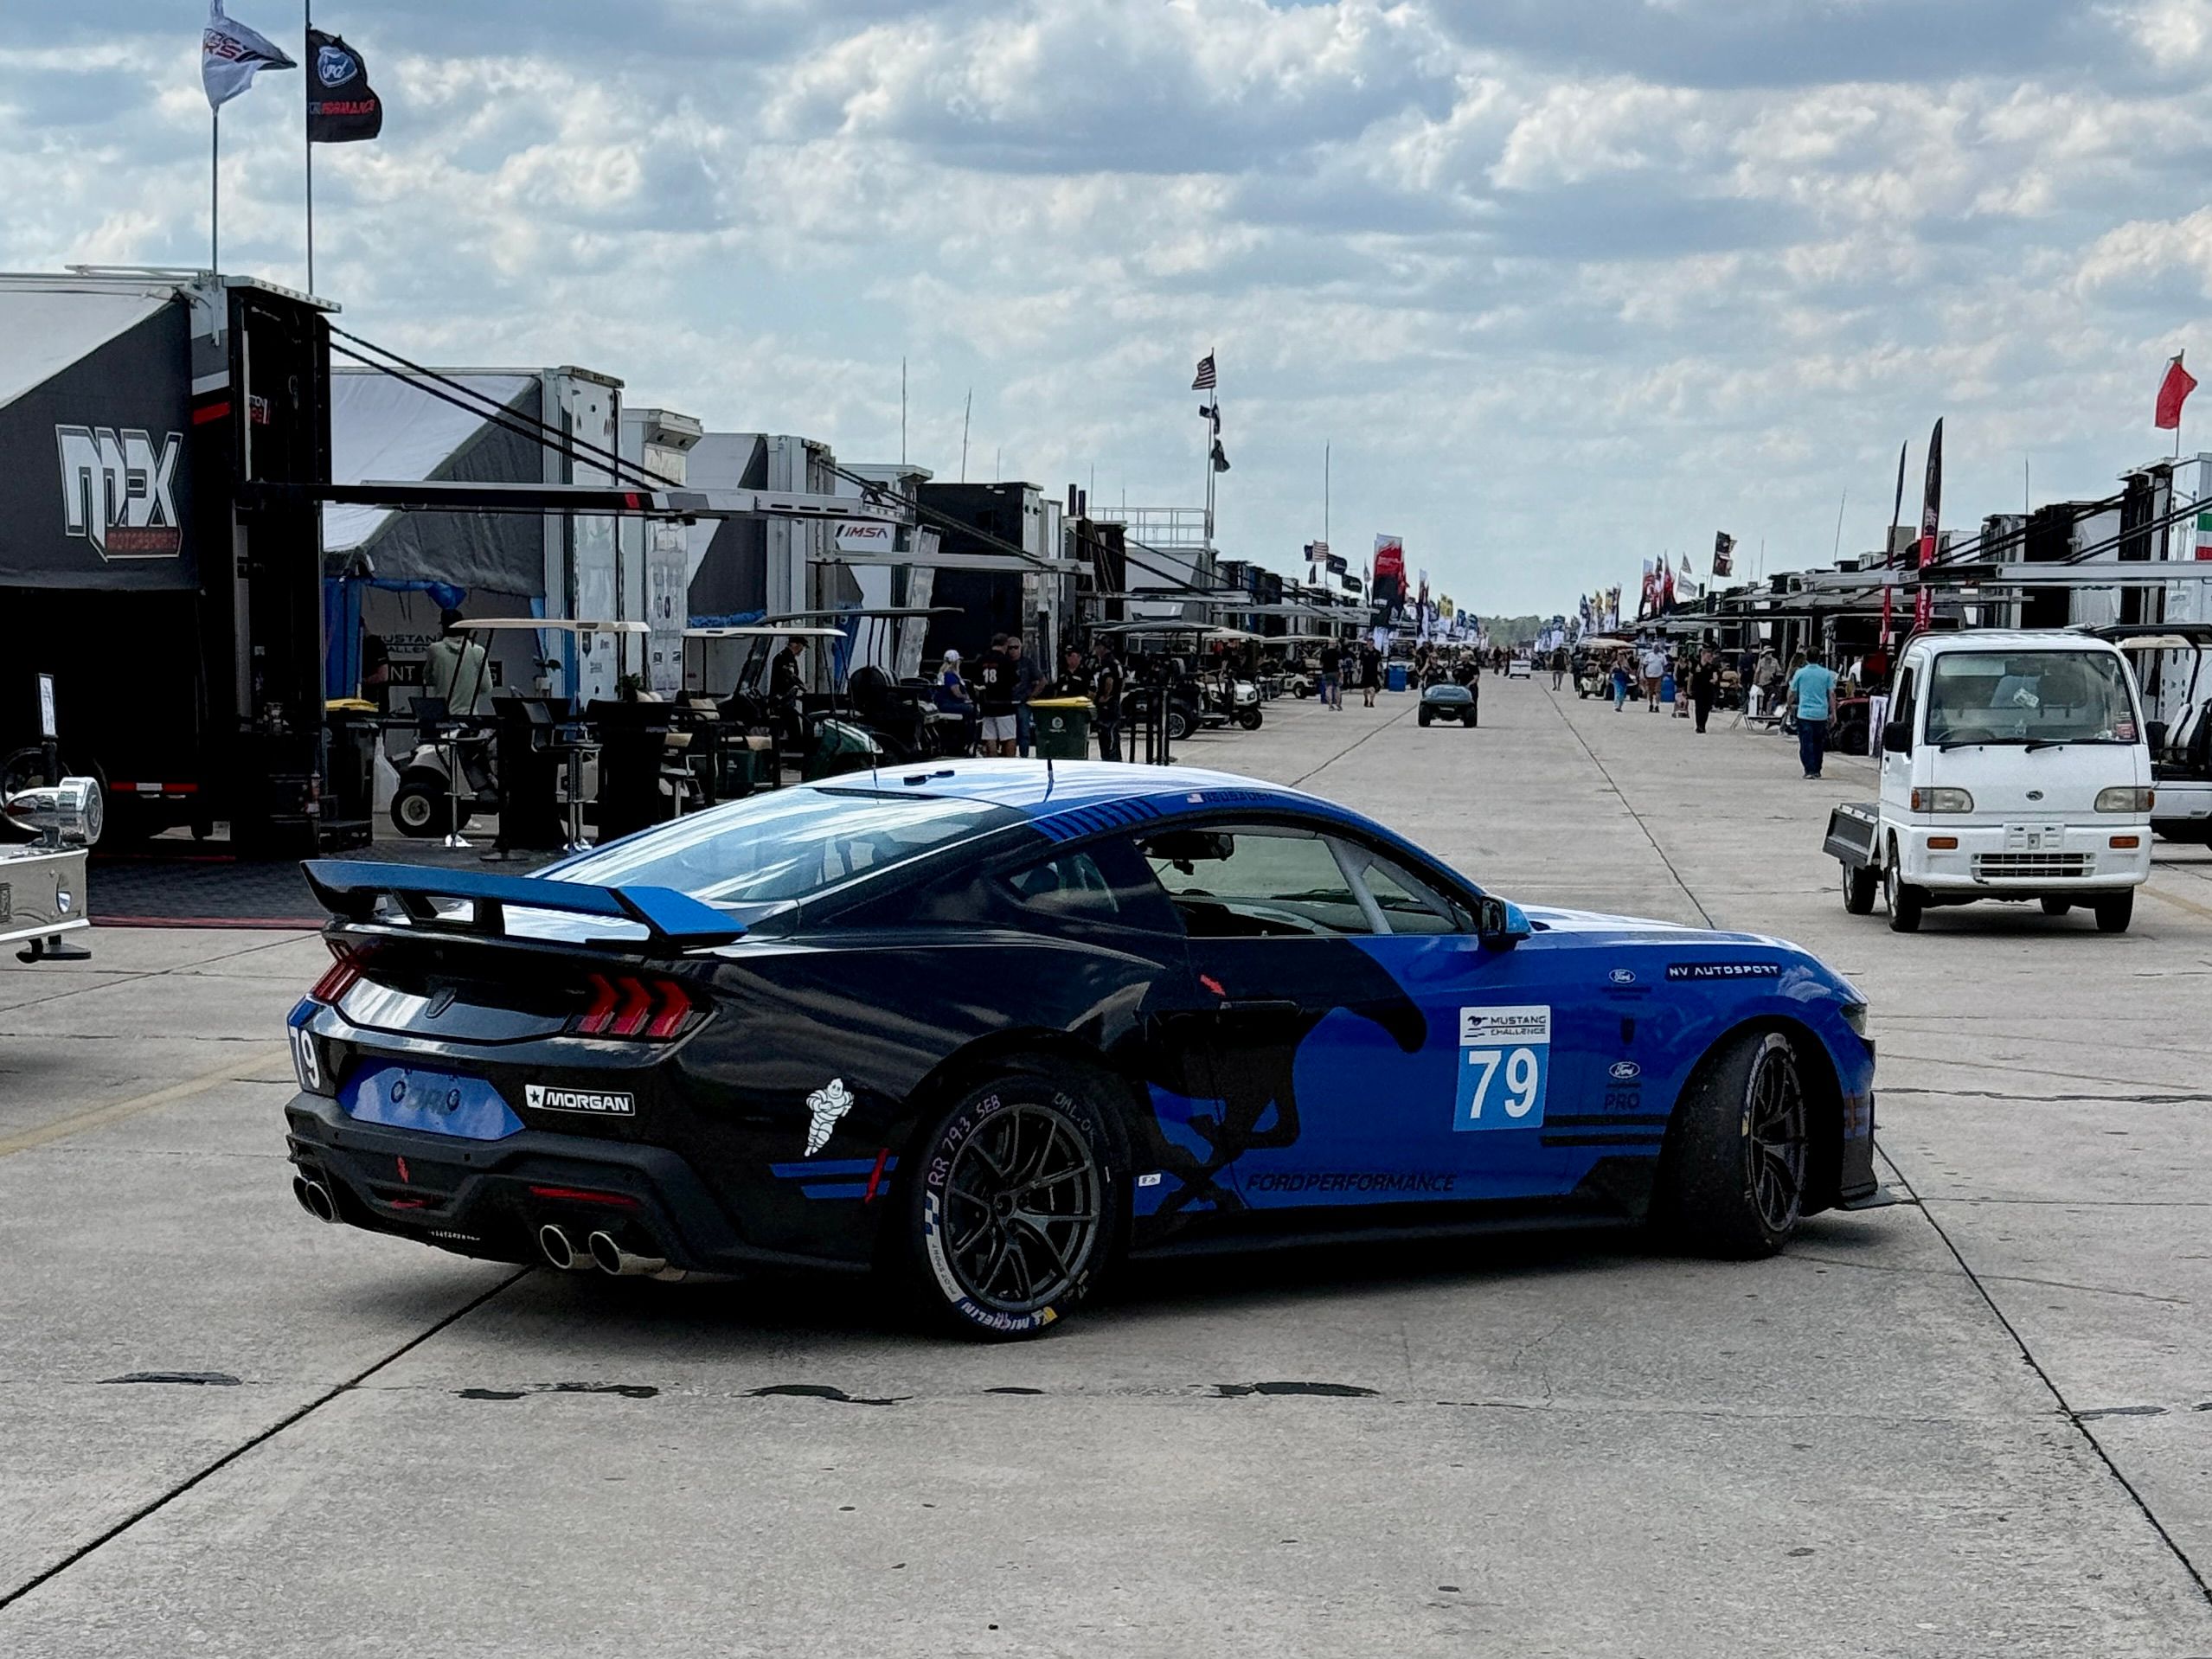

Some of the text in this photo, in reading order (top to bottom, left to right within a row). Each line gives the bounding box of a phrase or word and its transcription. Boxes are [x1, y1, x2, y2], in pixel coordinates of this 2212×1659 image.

[844, 526, 888, 539] IMSA
[982, 668, 997, 683] 18
[1669, 965, 1778, 977] NV AUTOSPORT
[1491, 1015, 1547, 1024] MUSTANG
[1491, 1028, 1546, 1036] CHALLENGE
[289, 1024, 321, 1089] 79
[1469, 1047, 1538, 1118] 79
[546, 1092, 631, 1111] MORGAN
[1605, 1092, 1640, 1110] PRO
[926, 1155, 951, 1188] RR
[975, 1093, 1002, 1119] SEB
[960, 1300, 1031, 1331] MICHELIN
